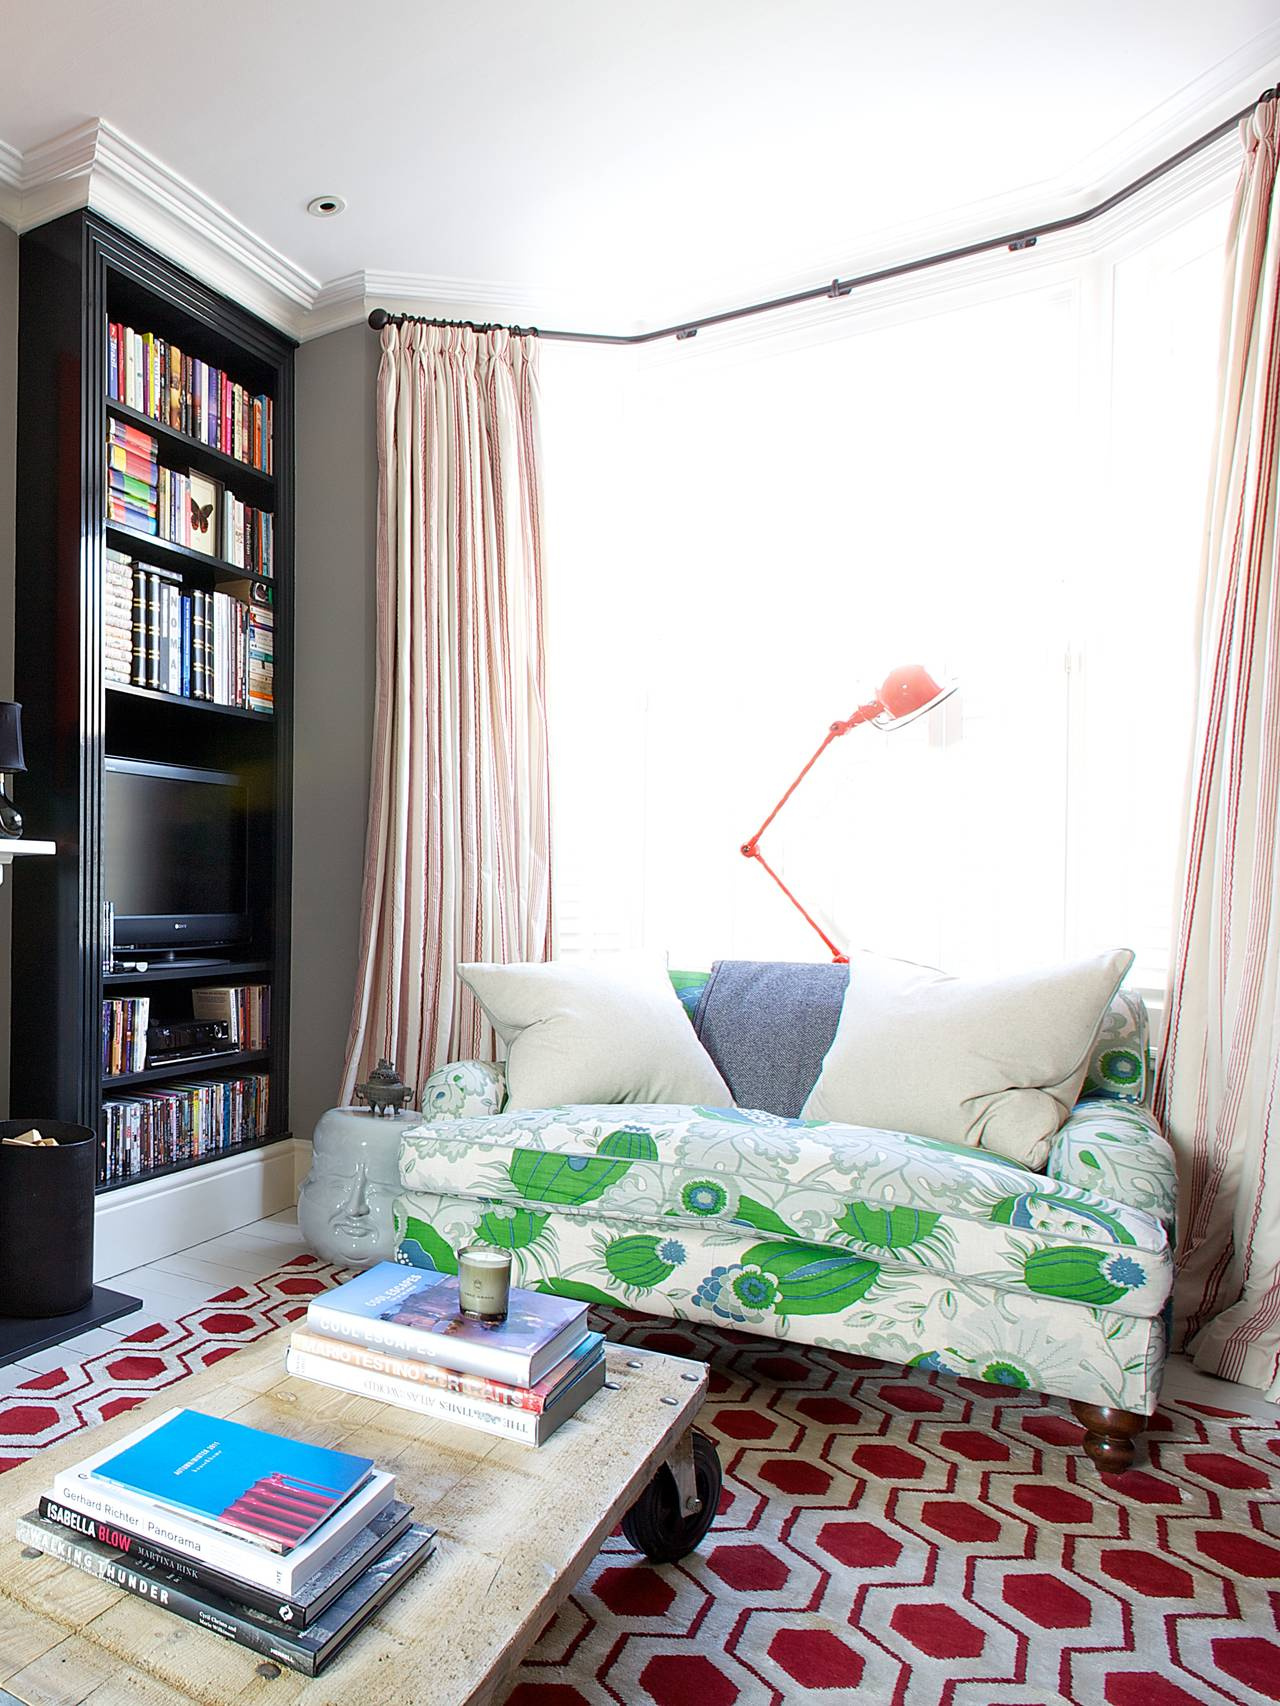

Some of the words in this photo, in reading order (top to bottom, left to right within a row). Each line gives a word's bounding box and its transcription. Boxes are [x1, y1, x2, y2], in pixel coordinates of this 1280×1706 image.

[320, 1318, 360, 1338] COOL
[363, 1328, 438, 1358] ESCAPES
[303, 1337, 354, 1362] MARIO
[354, 1350, 422, 1382] TESTINO
[421, 1366, 527, 1410] PORTRAITS
[406, 1390, 436, 1407] ATLAS
[439, 1401, 475, 1421] TIMES
[505, 1418, 529, 1434] THE
[46, 1502, 97, 1539] ISABELLA
[97, 1525, 132, 1552] BLOW
[137, 1546, 177, 1573] MARTINA
[176, 1563, 199, 1580] RINK
[62, 1487, 102, 1512] Gerhard
[104, 1503, 139, 1526] Richter
[147, 1520, 202, 1552] Panorama
[29, 1528, 94, 1568] WALKING
[97, 1559, 170, 1605] THUNDER
